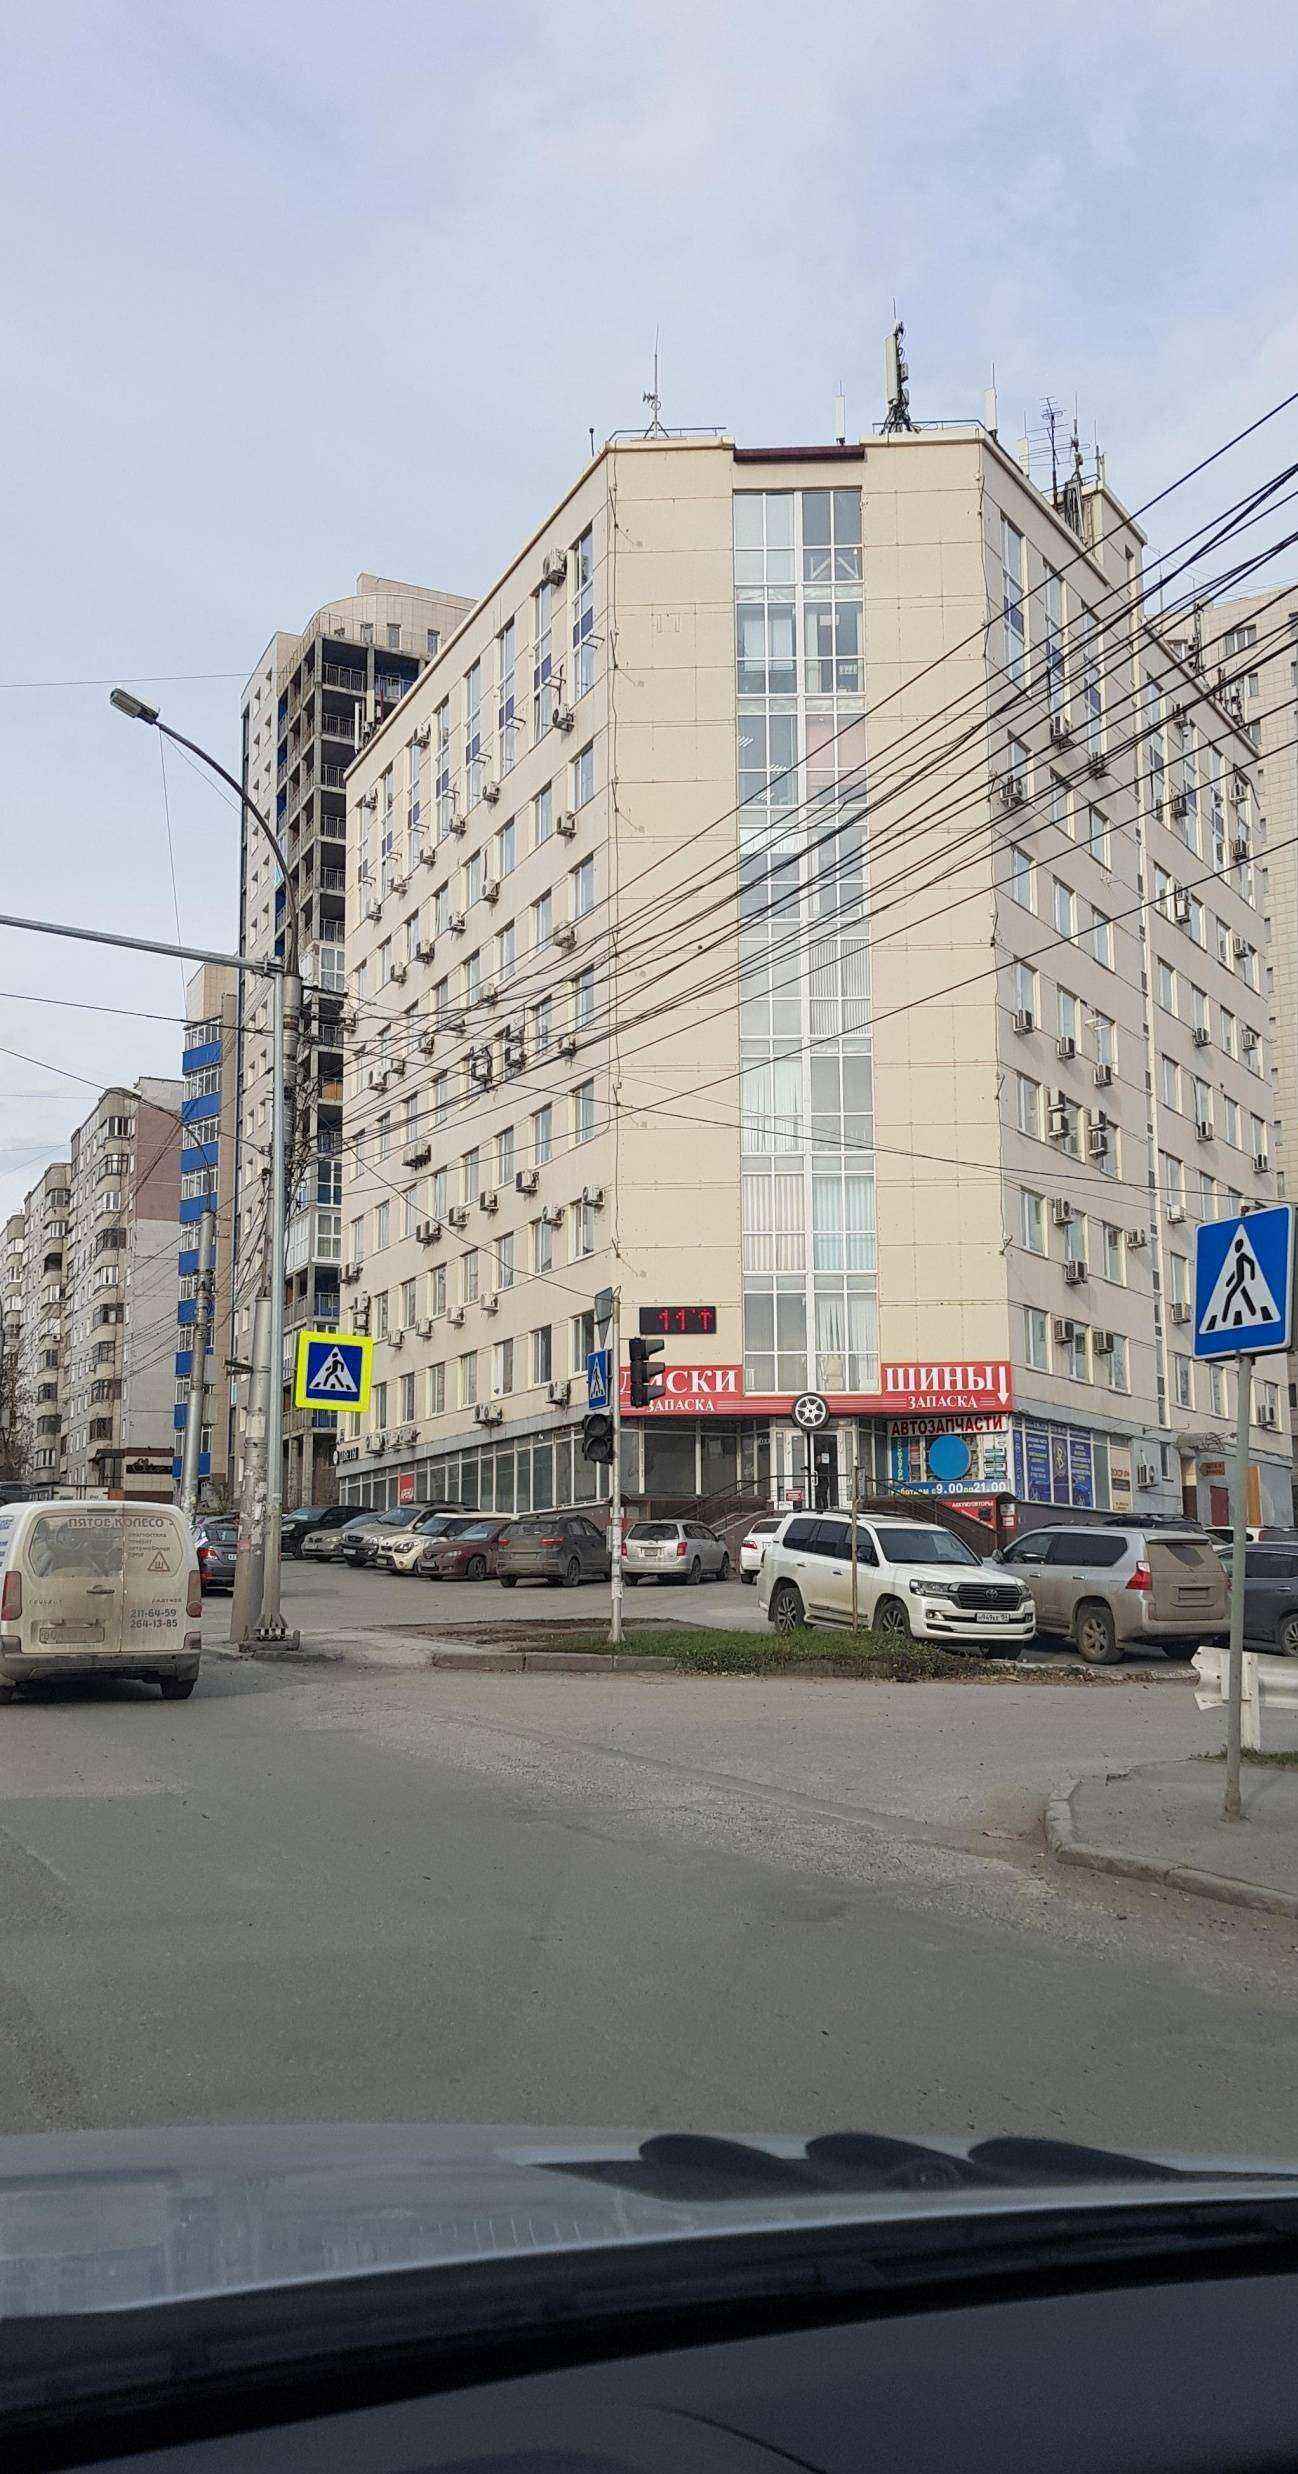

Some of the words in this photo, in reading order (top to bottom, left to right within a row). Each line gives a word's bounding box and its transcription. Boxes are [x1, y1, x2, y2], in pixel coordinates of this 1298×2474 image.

[886, 1366, 995, 1392] ШИНЫ
[647, 1398, 715, 1413] ЗАПАСКА
[907, 1395, 978, 1410] ЗАПАСКА
[891, 1415, 1003, 1436] АВТОЗАПЧАСТИ
[936, 1483, 964, 1495] 9.00
[973, 1481, 1007, 1493] 21.00
[67, 1518, 111, 1529] ПЯТОЕ
[115, 1518, 164, 1529] КОЛЕСО
[129, 1608, 177, 1619] 211-64-59
[129, 1619, 178, 1629] 264-13-85
